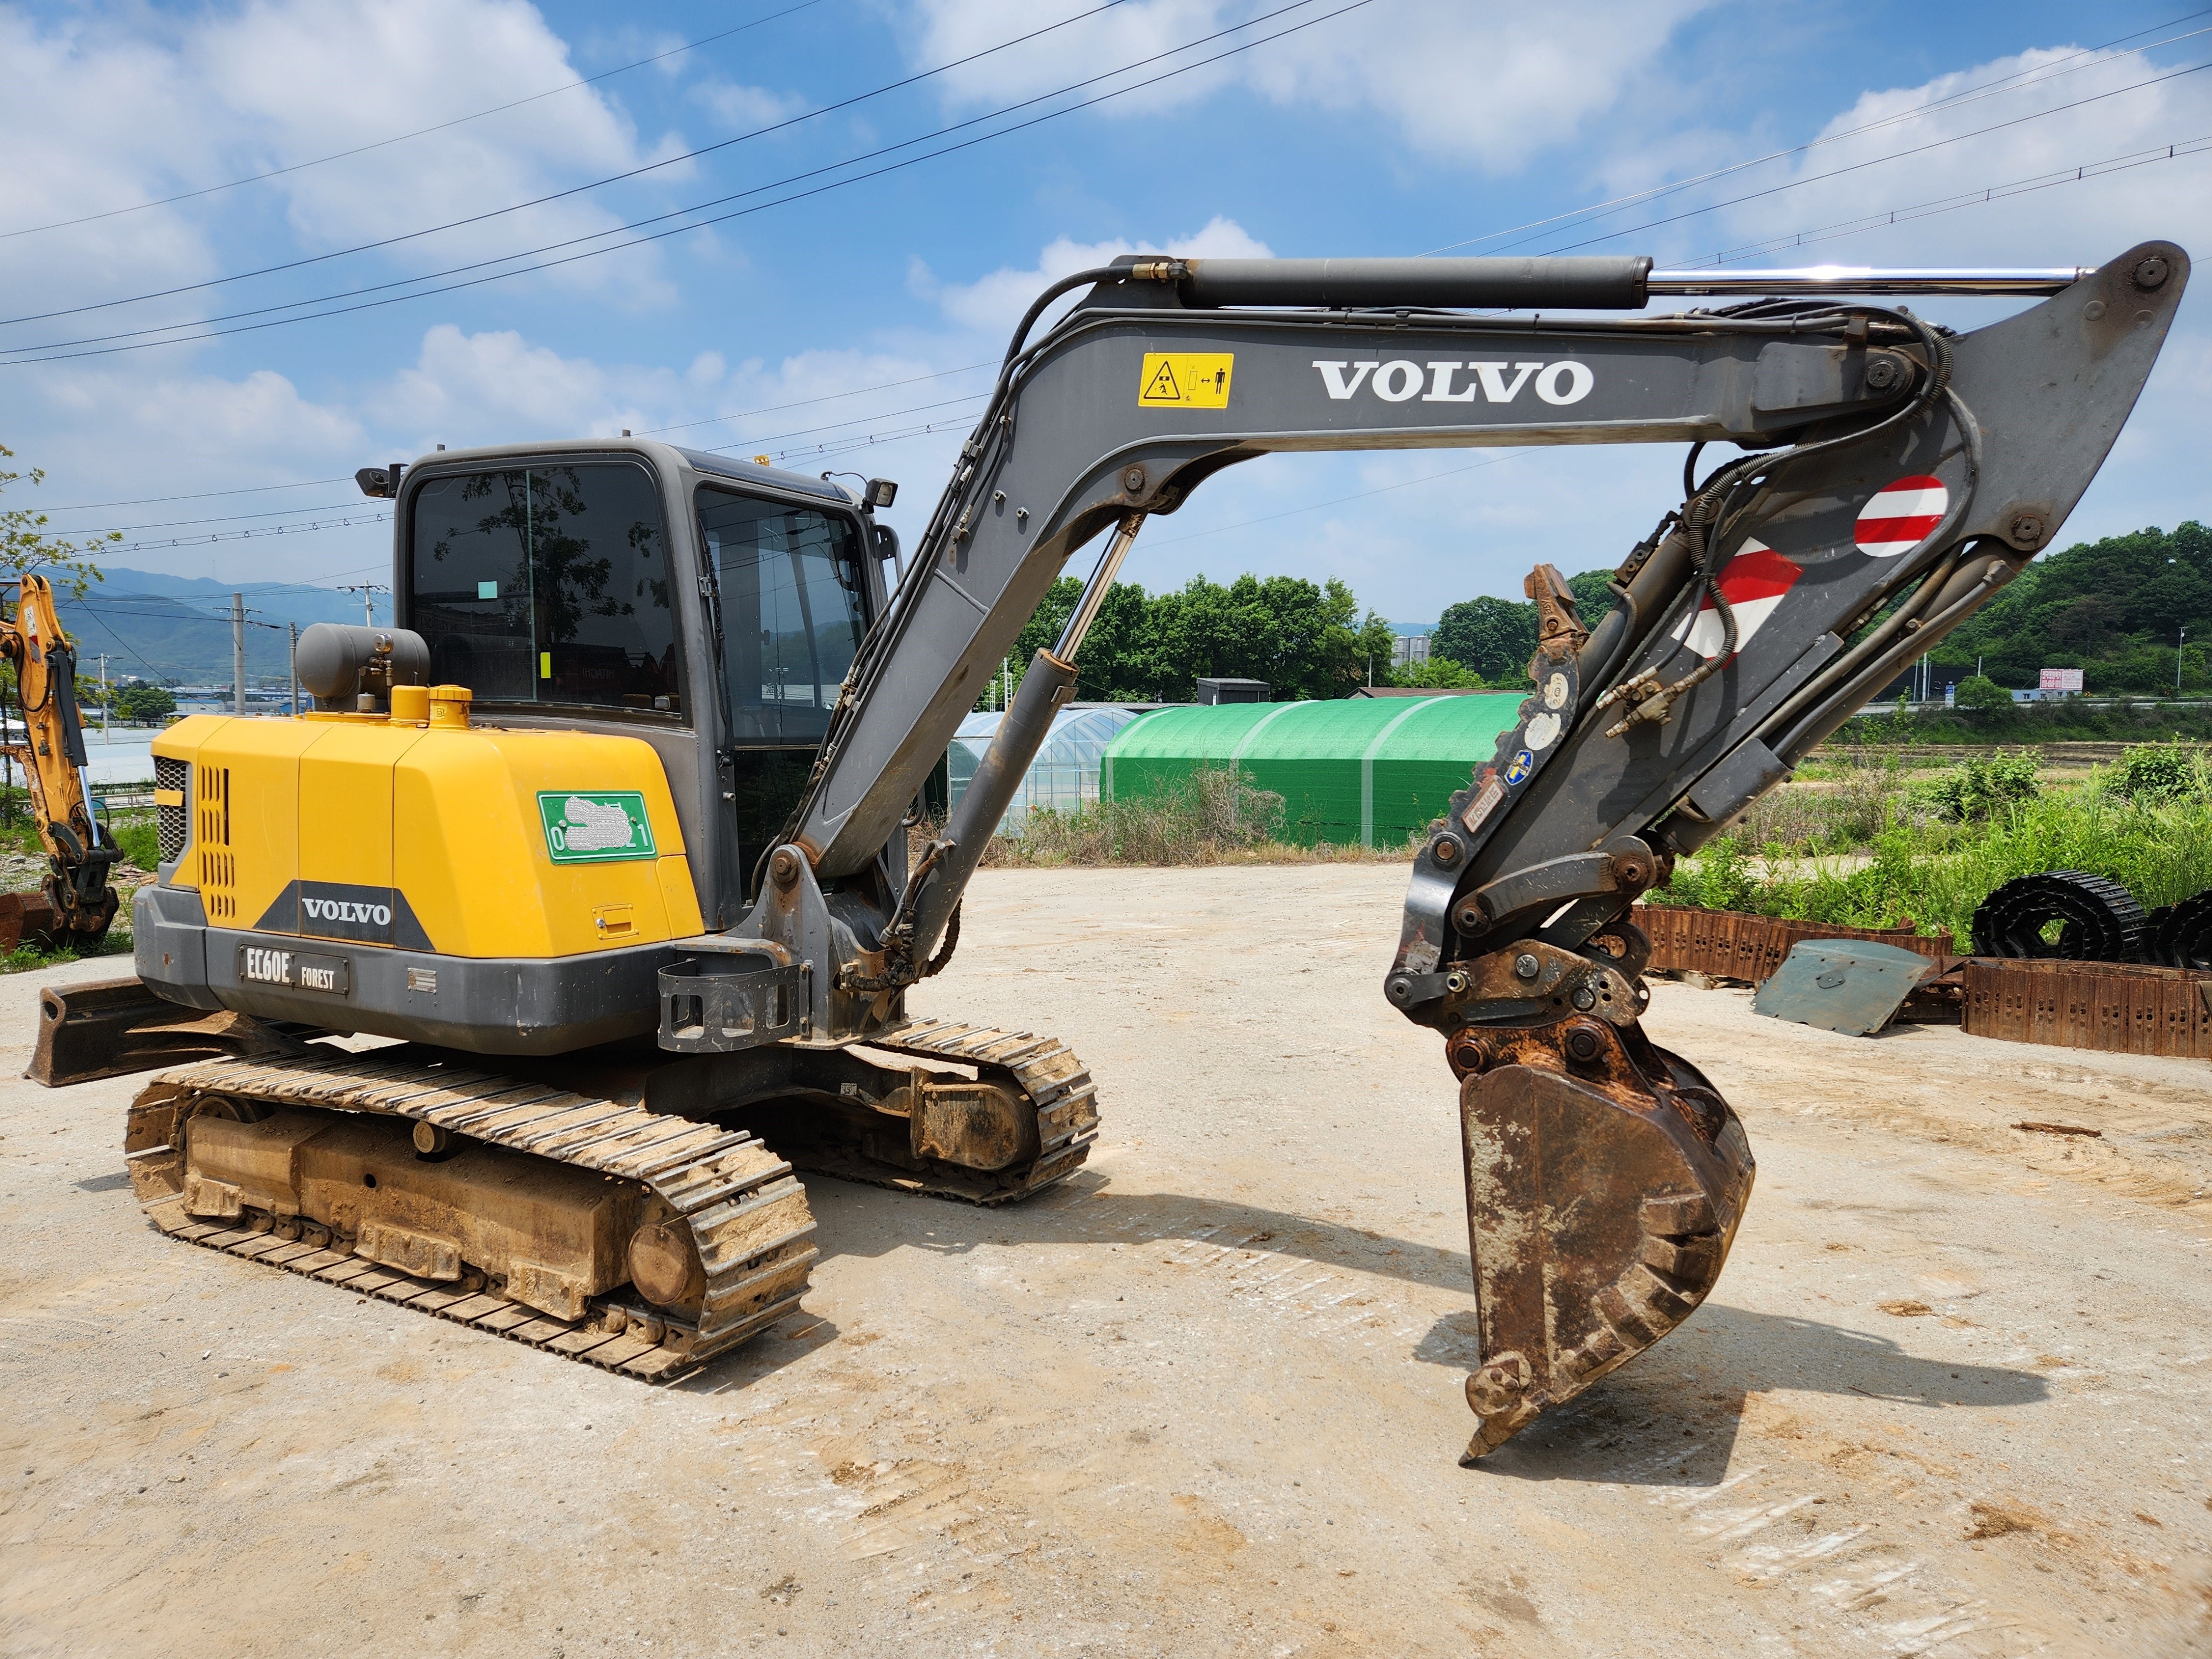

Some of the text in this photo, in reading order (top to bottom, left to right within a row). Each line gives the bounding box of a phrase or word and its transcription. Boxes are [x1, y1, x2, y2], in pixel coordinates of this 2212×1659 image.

[1312, 359, 1594, 406] VOLVO
[302, 898, 391, 925] VOLVO
[247, 948, 335, 989] EC60E FOREST
